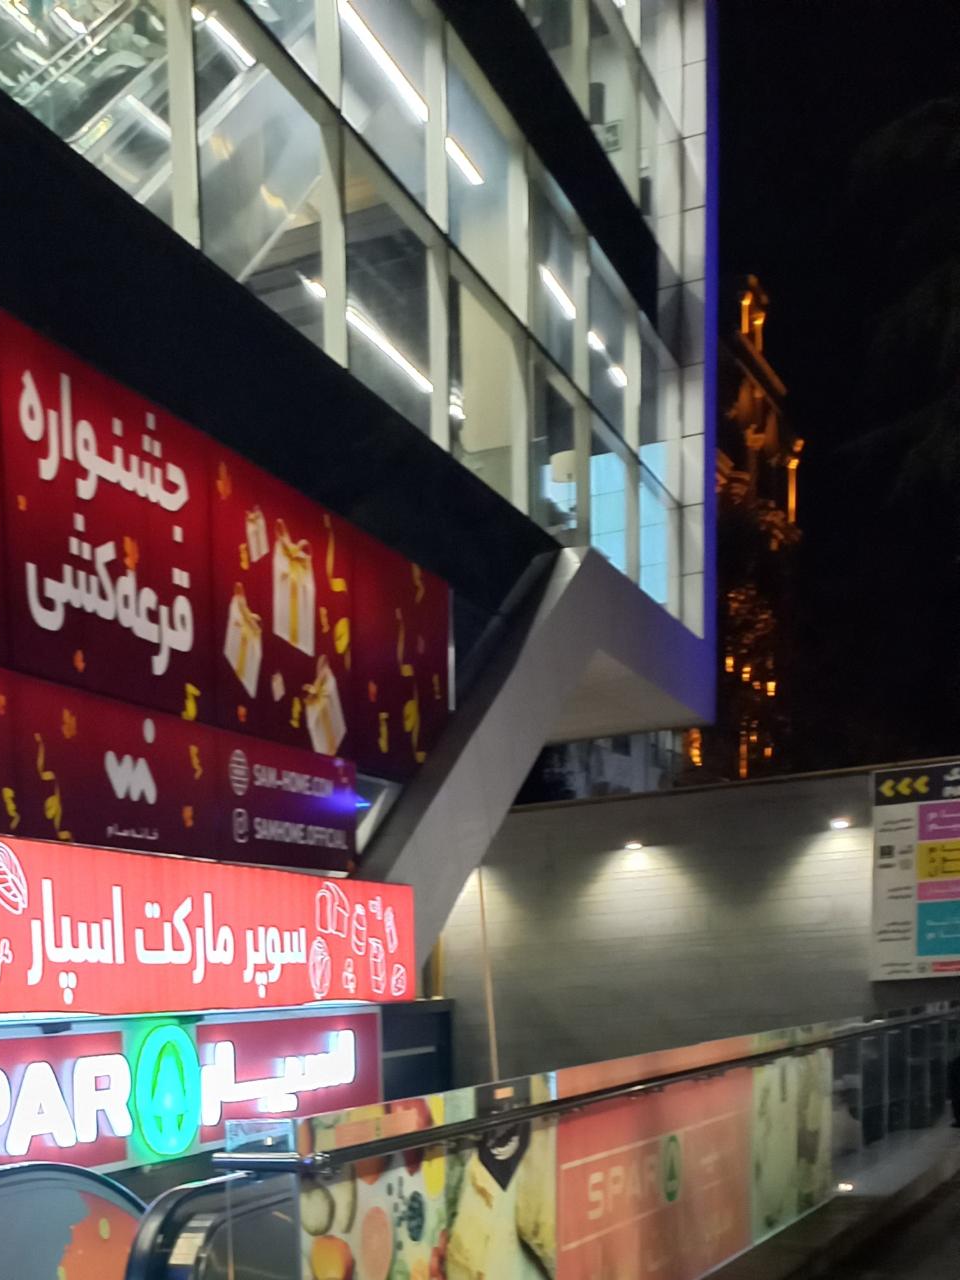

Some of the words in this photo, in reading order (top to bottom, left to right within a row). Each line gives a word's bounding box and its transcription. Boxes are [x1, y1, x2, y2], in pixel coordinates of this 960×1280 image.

[18, 368, 190, 512] جشنواره
[26, 878, 126, 1005] اسپار
[134, 891, 235, 985] مارکت
[242, 925, 308, 999] سوپر
